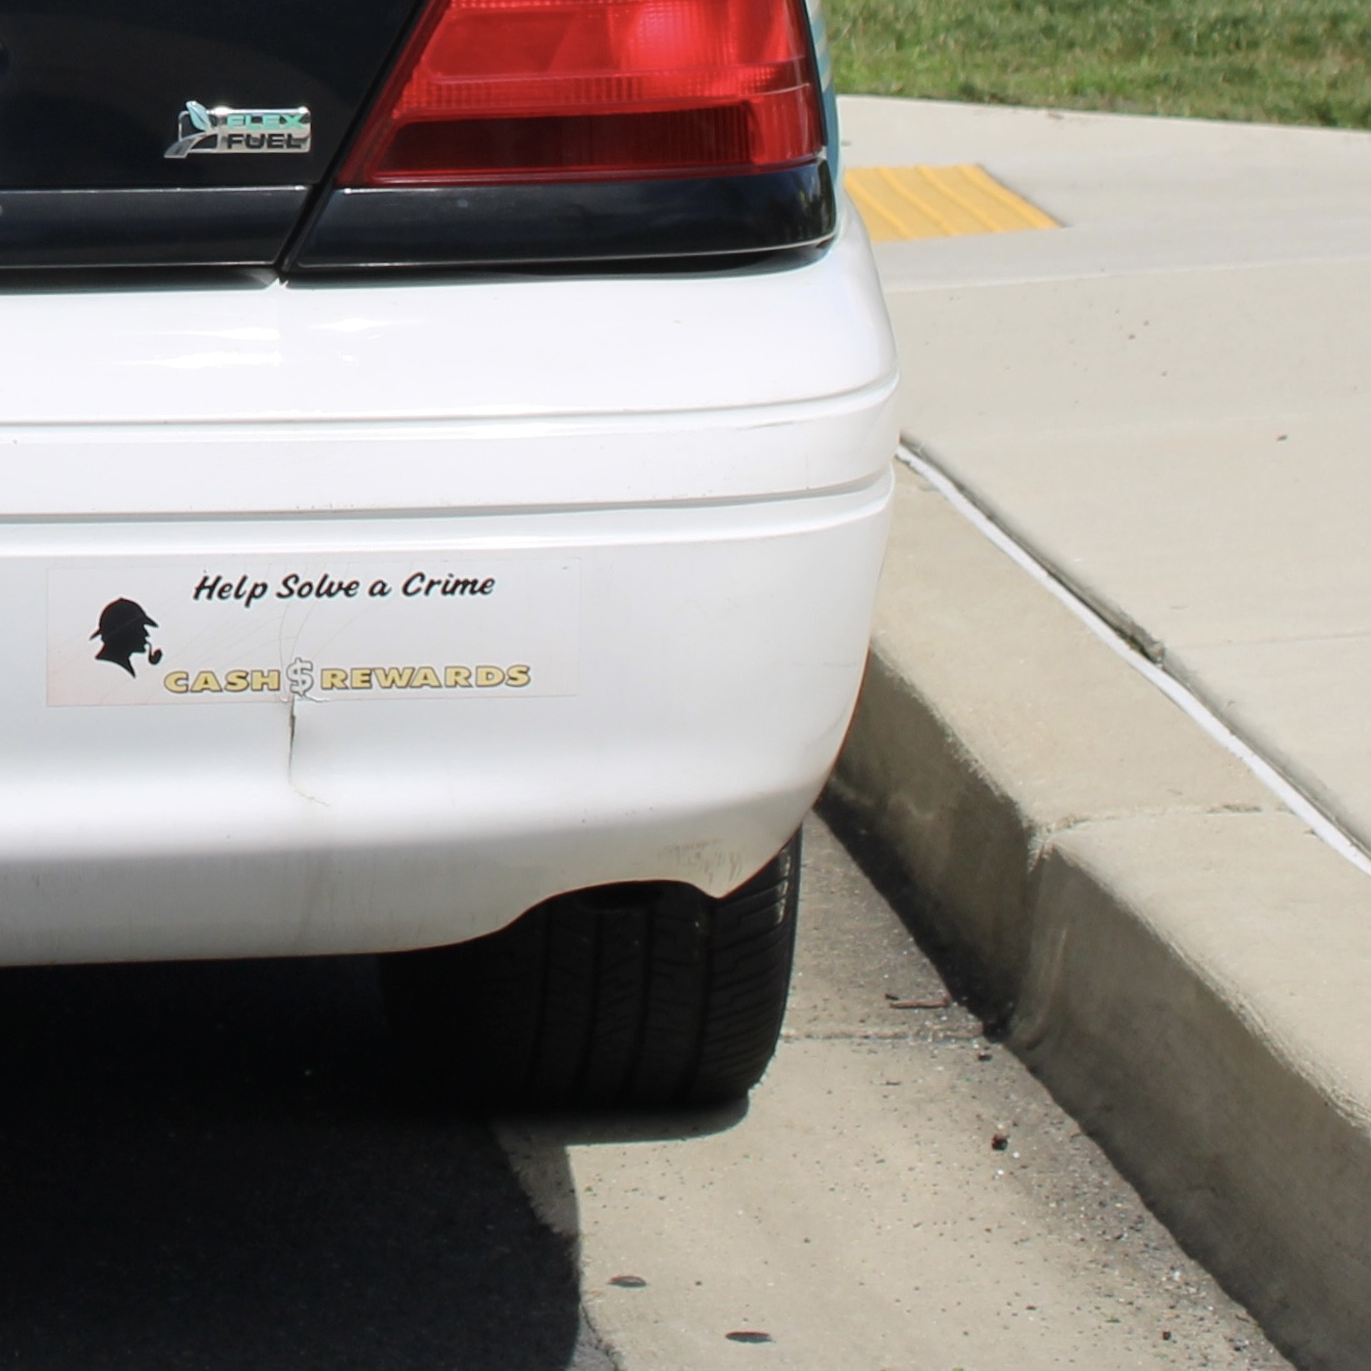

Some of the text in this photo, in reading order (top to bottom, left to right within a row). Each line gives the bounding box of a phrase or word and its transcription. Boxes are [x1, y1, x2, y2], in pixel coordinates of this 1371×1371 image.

[226, 113, 305, 129] FLEX
[227, 133, 302, 149] FUEL
[193, 571, 496, 607] Help Solve a Crime
[163, 670, 281, 694] CASH
[320, 664, 532, 691] REWARDS
